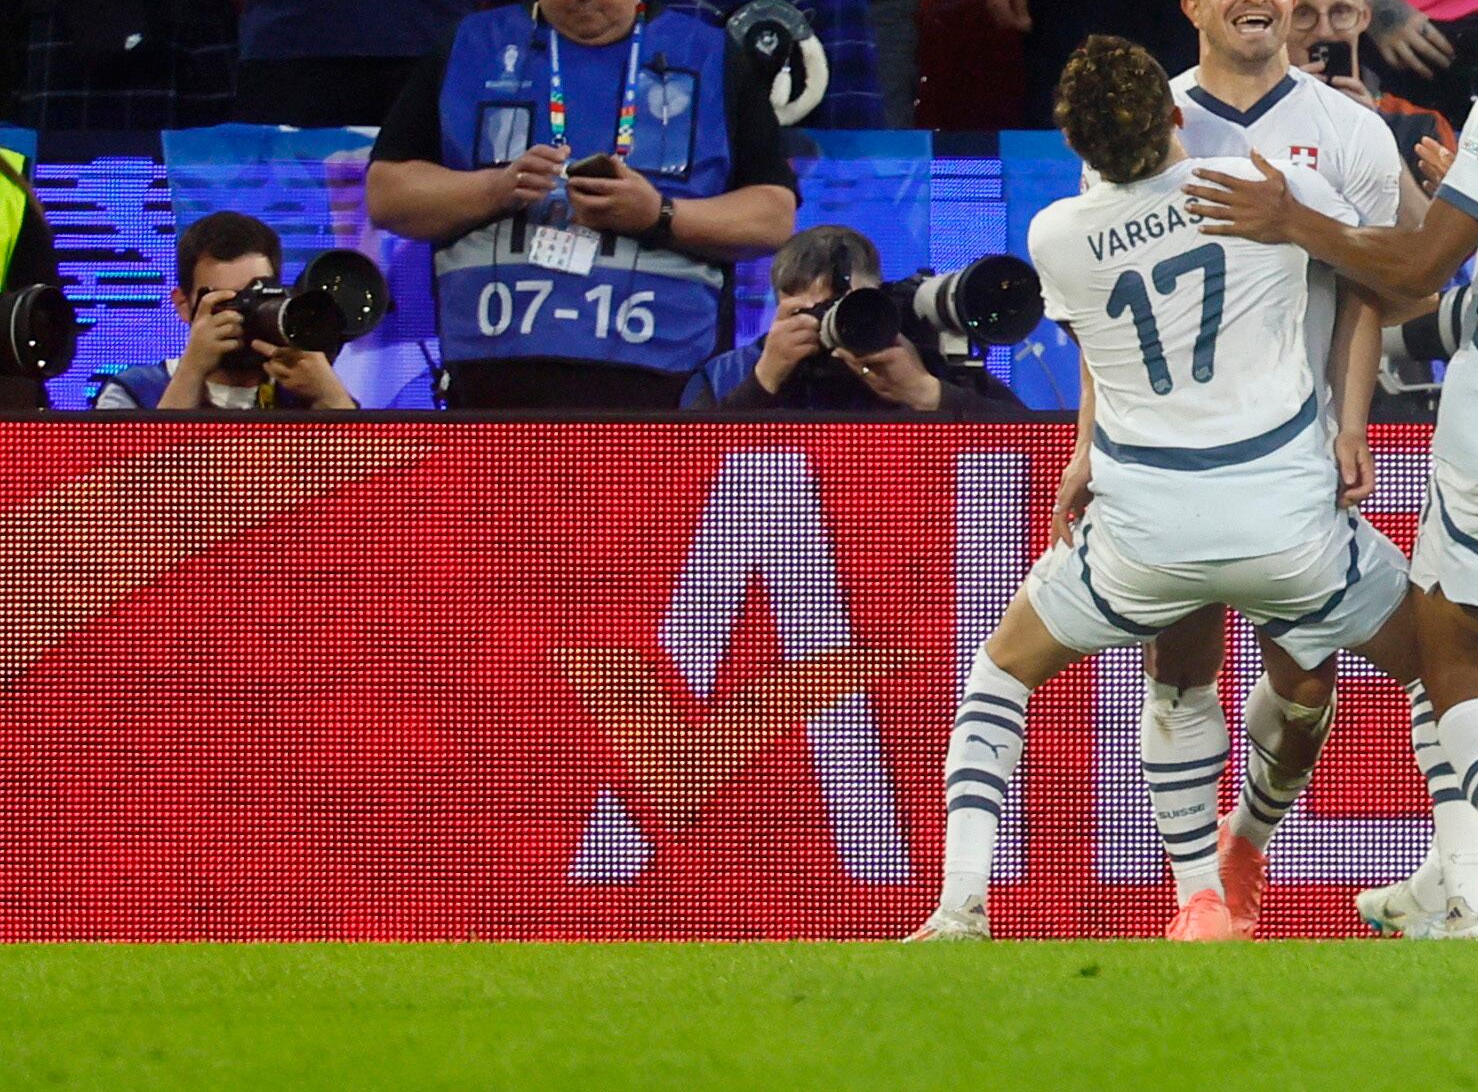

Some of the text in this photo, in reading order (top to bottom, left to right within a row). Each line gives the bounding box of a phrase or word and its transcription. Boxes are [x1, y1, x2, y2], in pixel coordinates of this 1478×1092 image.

[1087, 196, 1205, 262] VARGAS
[477, 279, 655, 344] 07-16
[1106, 242, 1226, 396] 17
[1158, 803, 1206, 819] SUISSE
